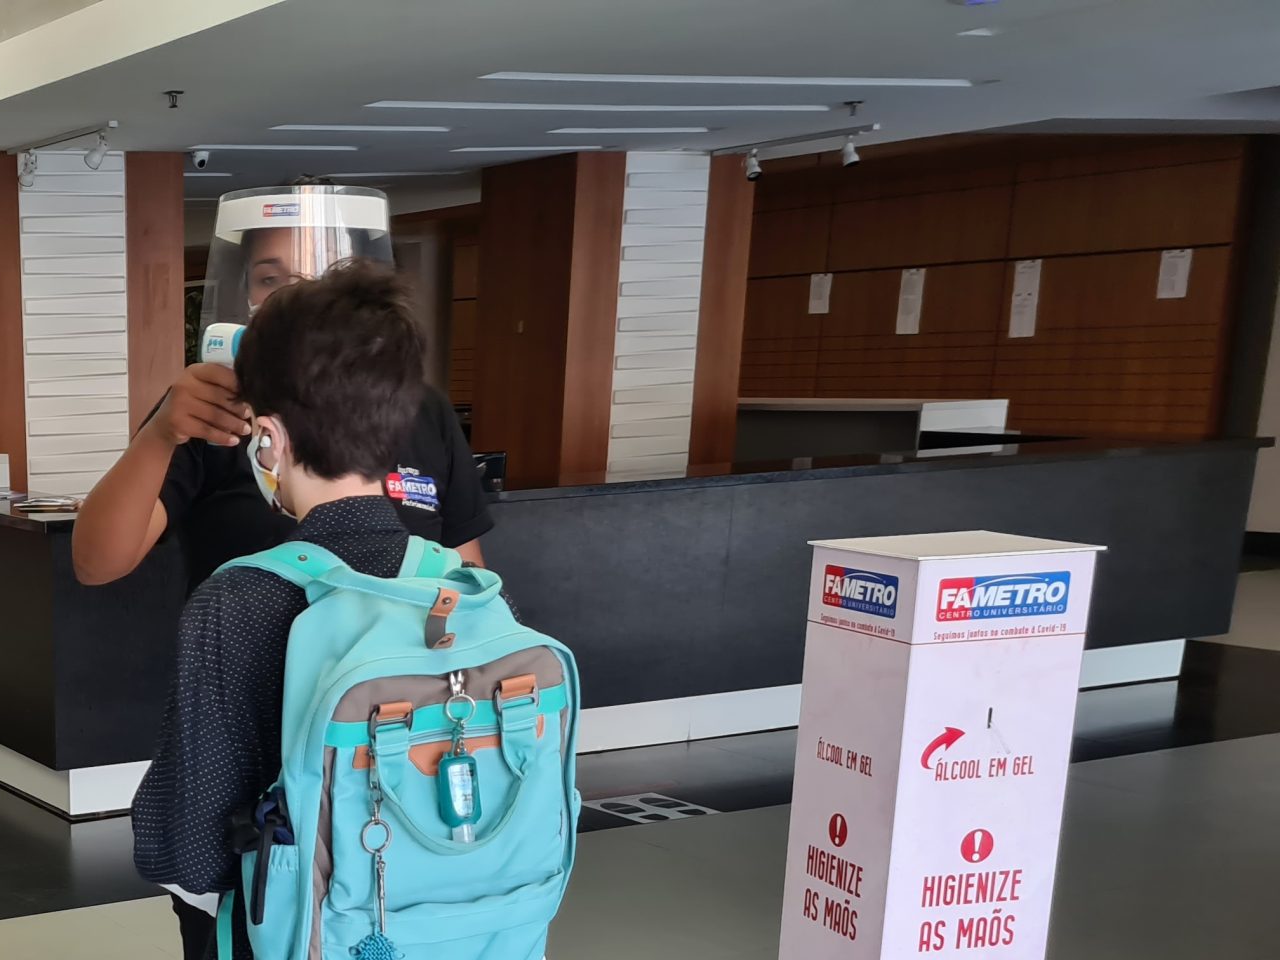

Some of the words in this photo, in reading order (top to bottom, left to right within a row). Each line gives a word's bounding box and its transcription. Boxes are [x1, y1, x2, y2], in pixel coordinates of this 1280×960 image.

[387, 480, 437, 495] FAMETRO
[825, 574, 896, 606] FAMETRO
[939, 580, 1067, 610] FAMETRO
[938, 609, 980, 620] CENTRO
[983, 603, 1064, 617] UNIVERSITÁRIO
[816, 736, 843, 767] ÁLCOOL
[846, 750, 858, 770] EM
[860, 754, 873, 778] GEL
[935, 757, 982, 782] ÁLCOOL
[988, 757, 1007, 778] EM
[1012, 755, 1034, 776] GEL
[806, 844, 864, 899] HIGIENIZE
[921, 869, 1023, 908] HIGIENIZE
[803, 888, 819, 922] AS
[823, 896, 858, 942] MAÕS
[918, 920, 946, 952] AS
[955, 908, 1016, 950] MAÕS
